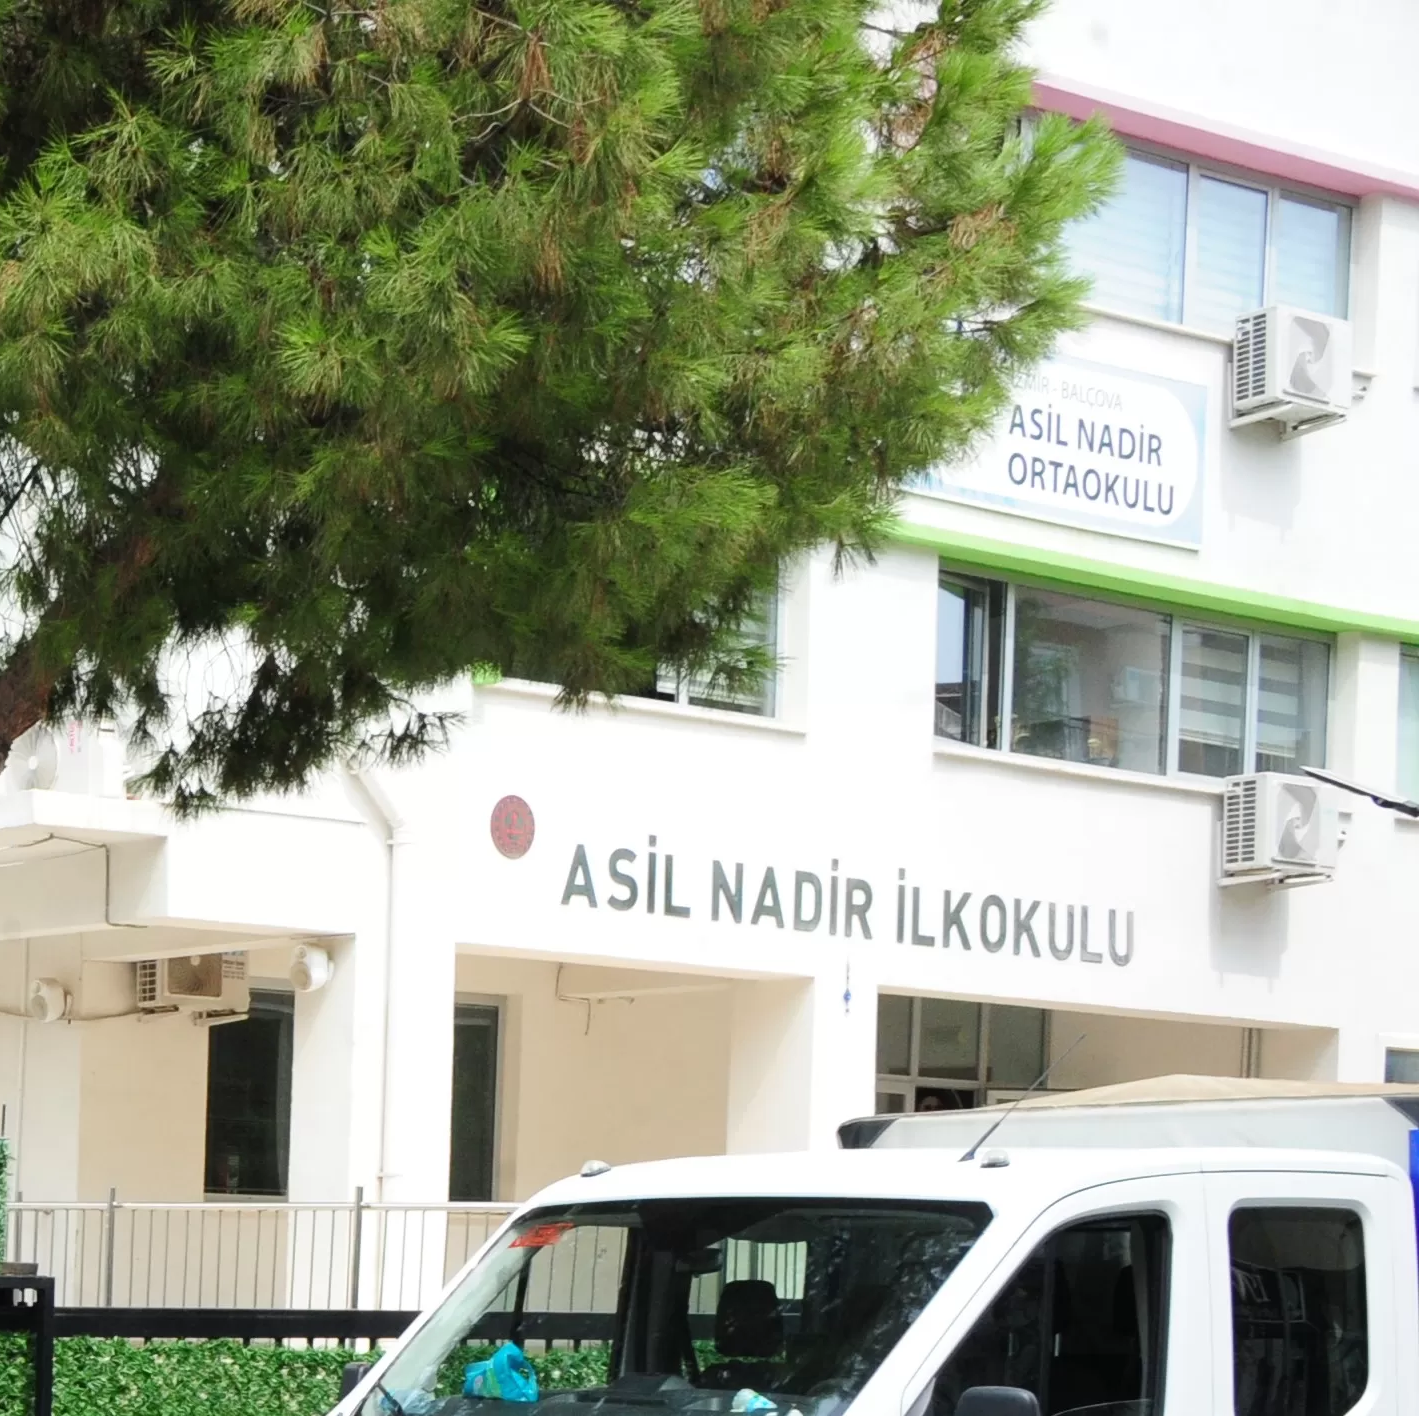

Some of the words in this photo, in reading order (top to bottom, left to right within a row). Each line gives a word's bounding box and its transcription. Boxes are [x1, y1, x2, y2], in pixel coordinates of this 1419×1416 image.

[1061, 380, 1123, 411] BALÇOVA
[1009, 403, 1068, 447] ASİL
[1077, 418, 1163, 467] NADİR
[1008, 452, 1174, 516] ORTAOKULU
[560, 834, 691, 918] ASİL
[711, 858, 873, 940] NADİR
[896, 867, 1135, 967] İLKOKULU
